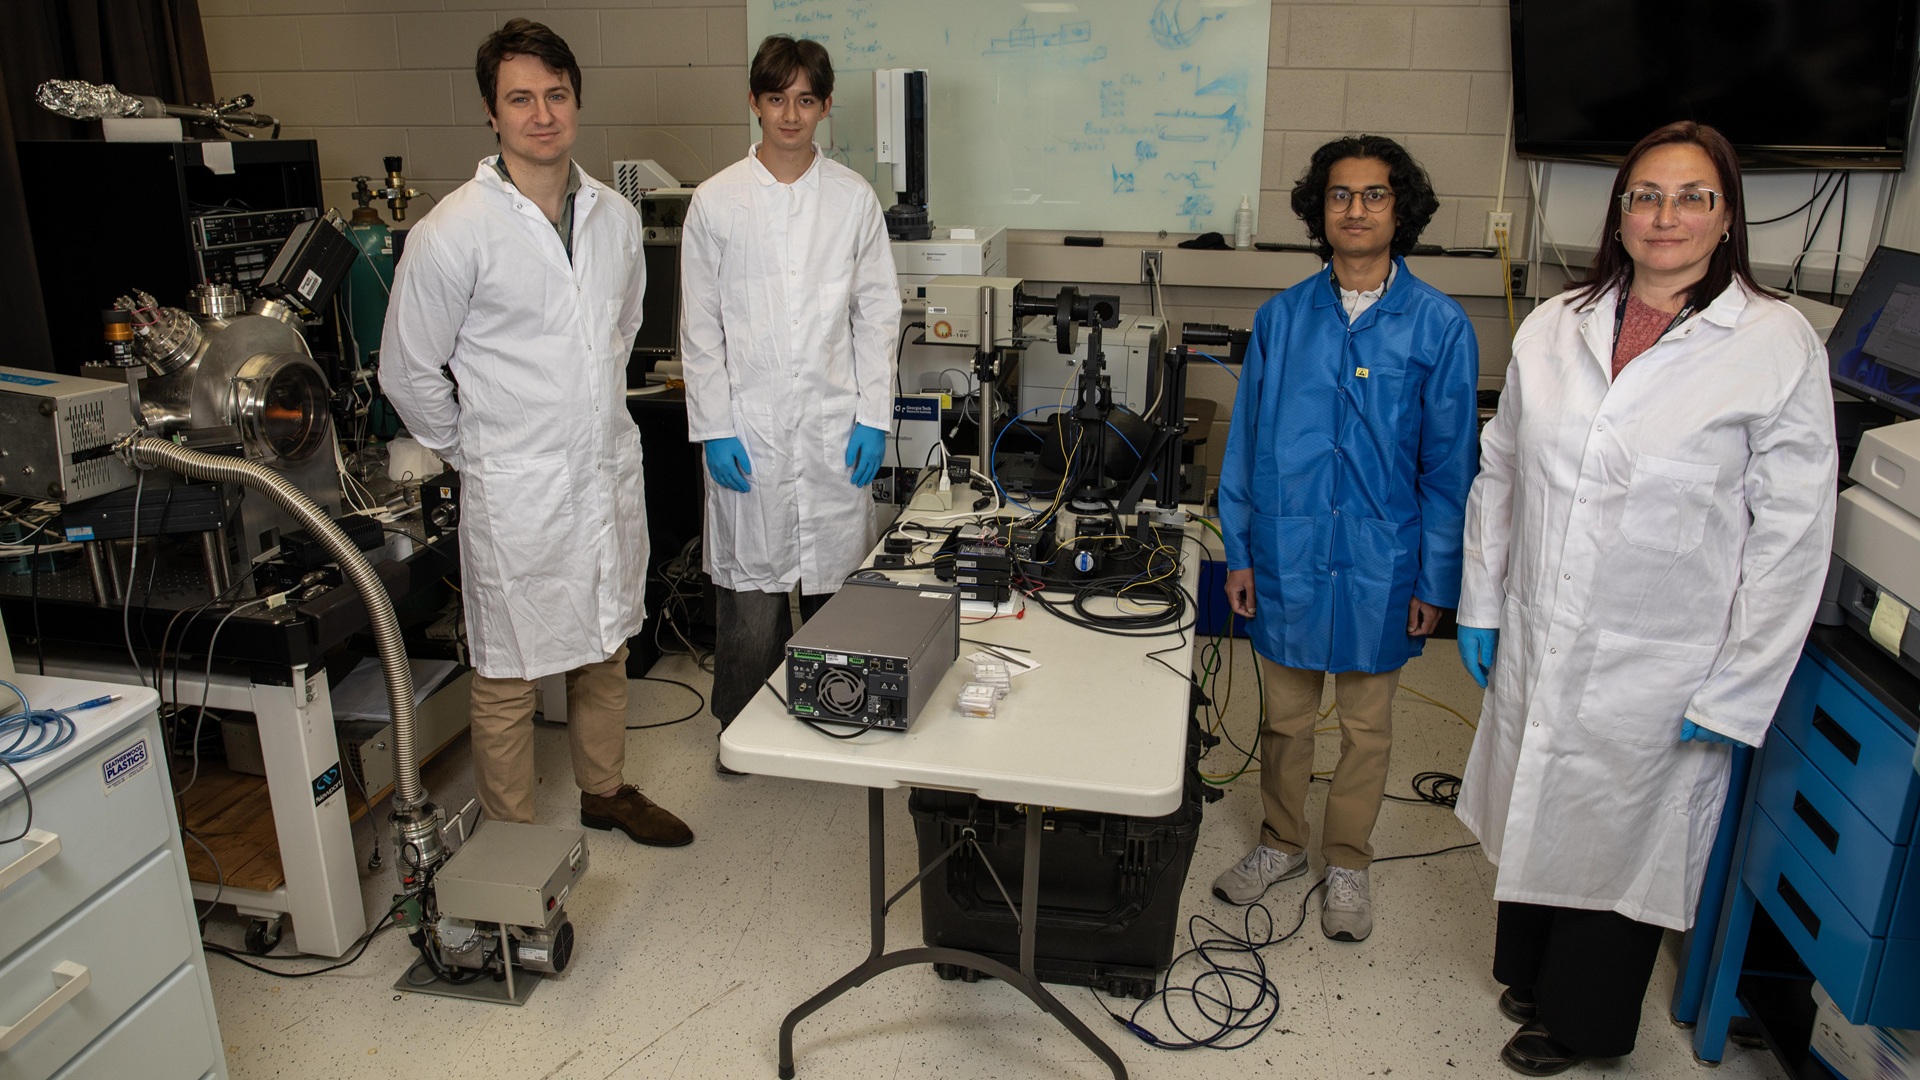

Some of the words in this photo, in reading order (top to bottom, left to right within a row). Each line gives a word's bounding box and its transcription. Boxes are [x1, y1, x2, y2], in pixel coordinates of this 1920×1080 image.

[105, 744, 144, 771] LEATHERWOOD
[106, 750, 145, 780] PLASTICS
[315, 779, 342, 805] Newport
